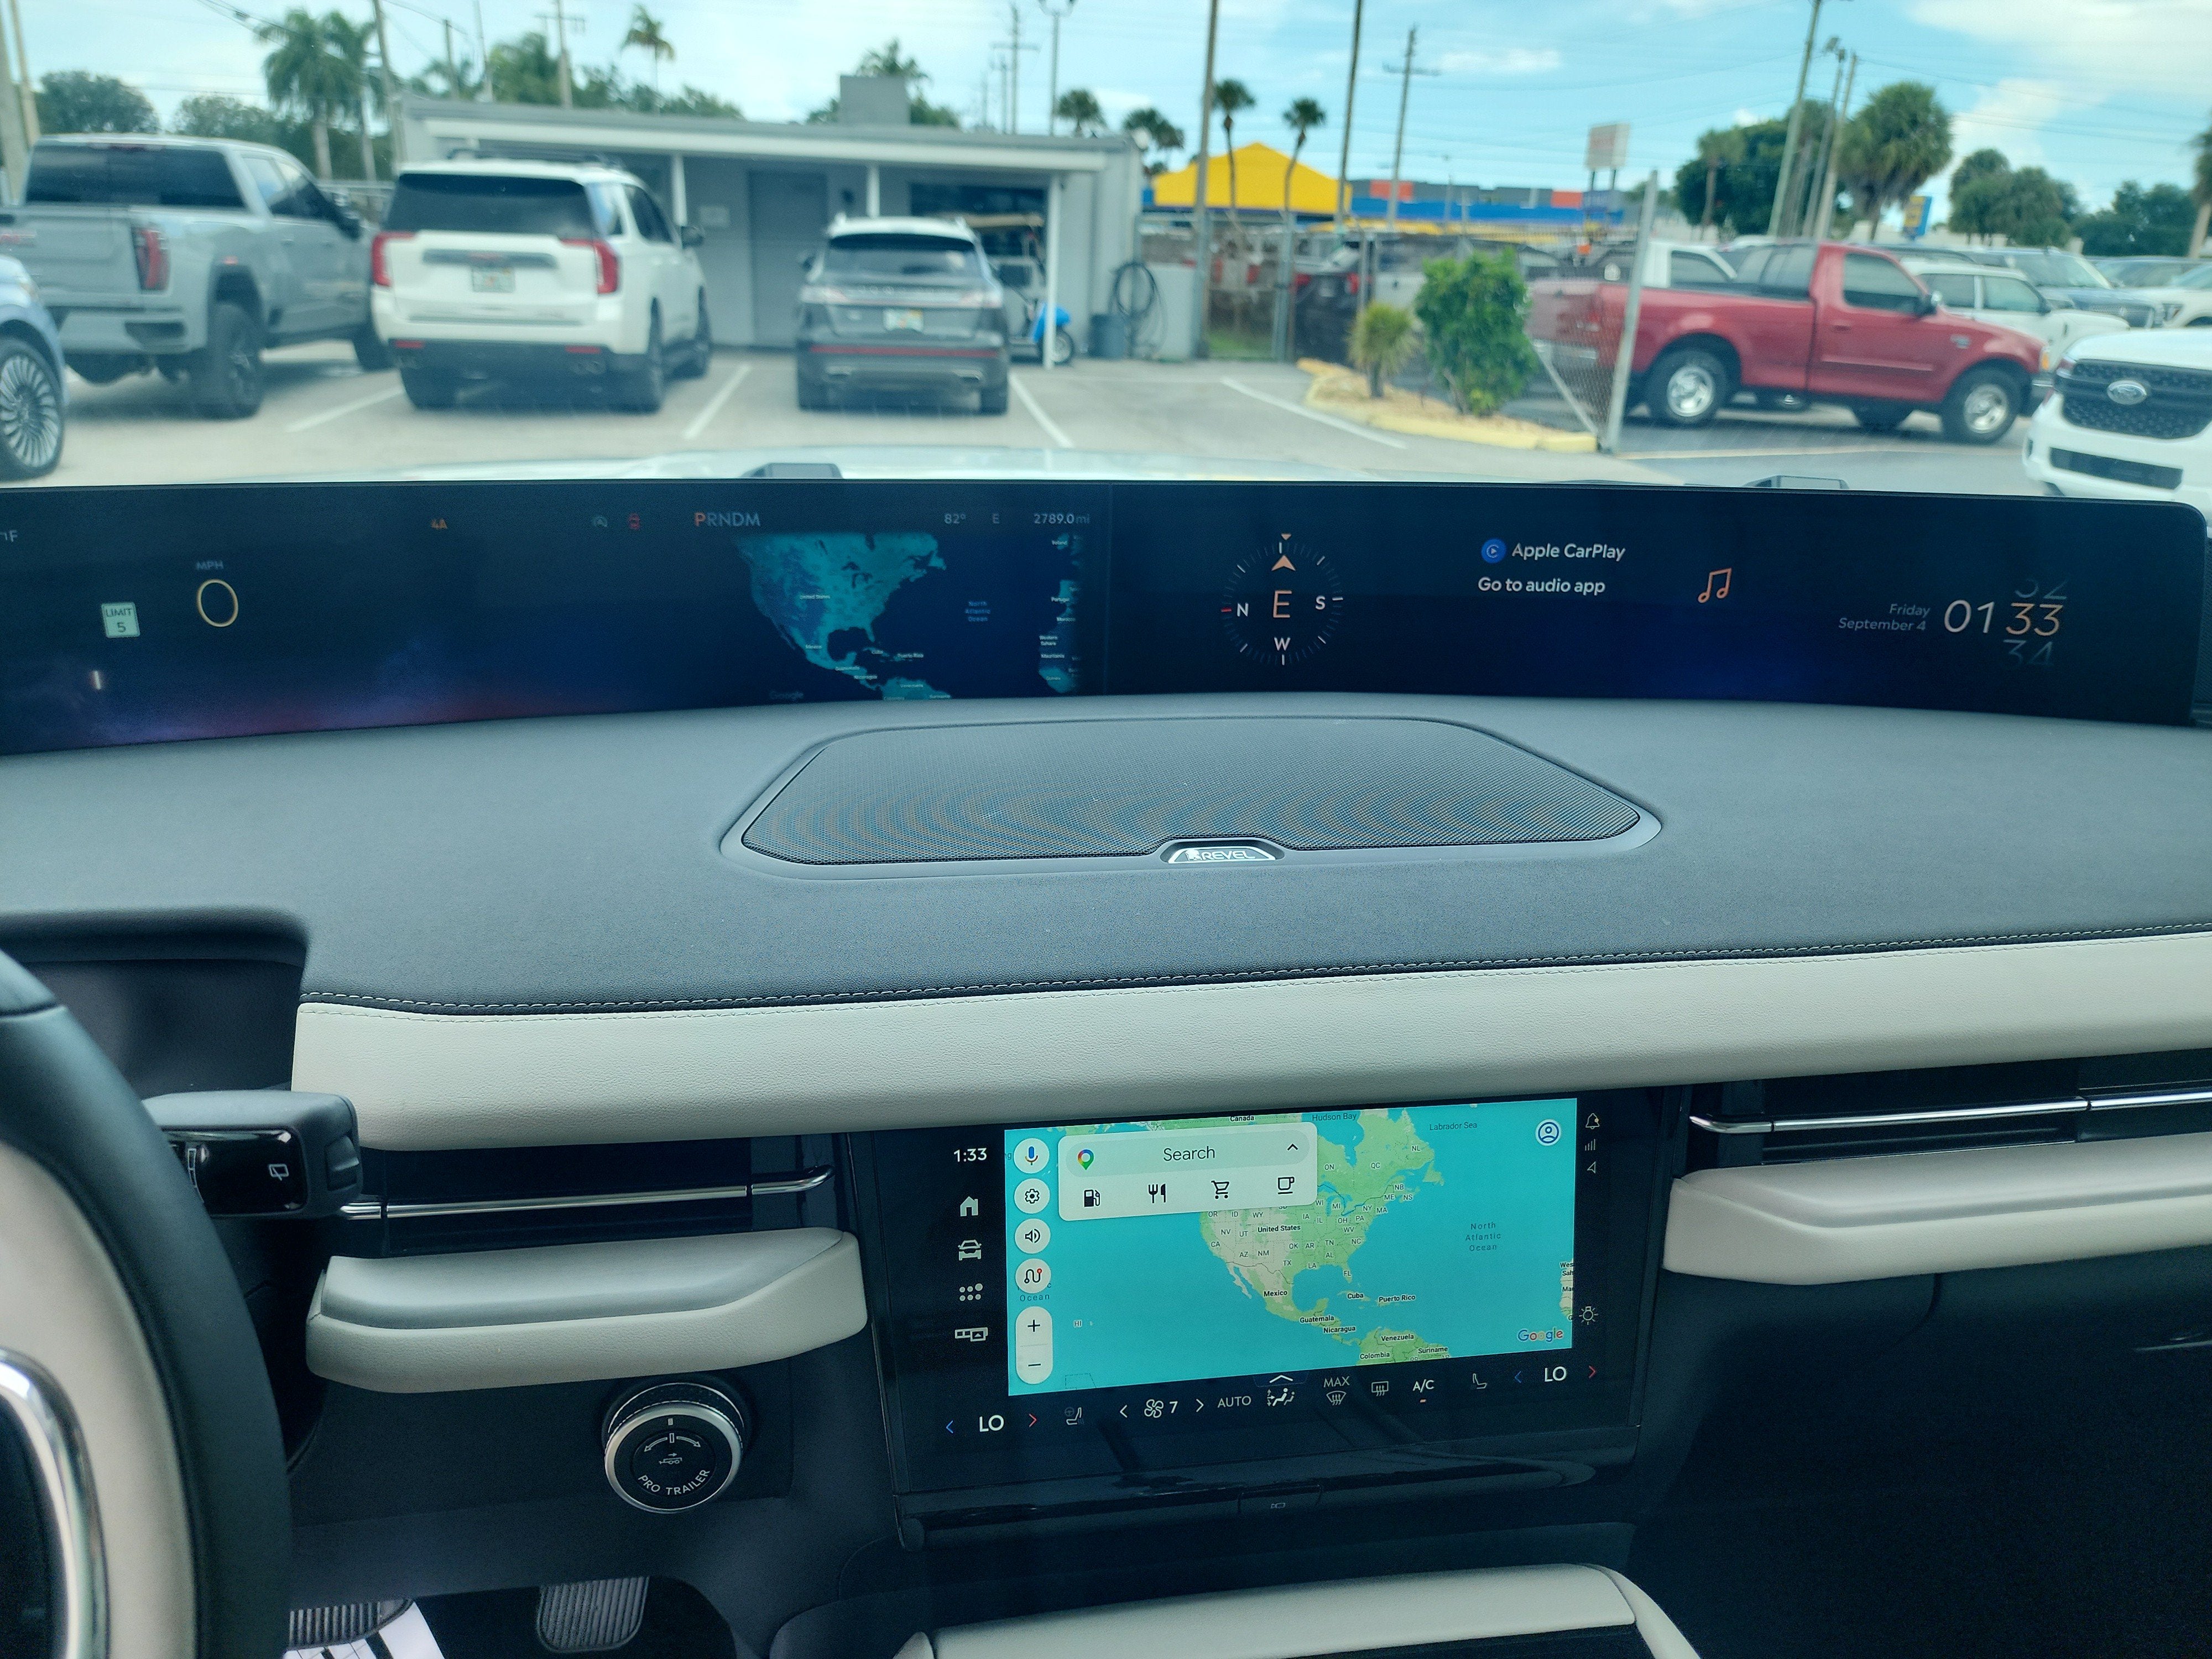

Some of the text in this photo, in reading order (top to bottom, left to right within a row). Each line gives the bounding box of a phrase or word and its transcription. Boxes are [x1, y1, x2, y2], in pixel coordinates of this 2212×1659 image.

[695, 512, 760, 526] PRNDM
[944, 514, 966, 524] 82°
[993, 514, 999, 524] E
[1034, 514, 1074, 524] 2789.0
[1512, 543, 1626, 561] Apple CarPlay
[196, 561, 223, 570] MPH
[1478, 577, 1606, 596] Go to audio app
[1237, 602, 1249, 617] N
[1273, 589, 1292, 618] E
[1316, 596, 1326, 610] S
[106, 608, 132, 617] LIMIT
[1890, 603, 1930, 618] Friday
[1838, 617, 1926, 632] September 4
[1944, 599, 2063, 637] 01 33
[117, 622, 126, 633] 5
[1274, 637, 1291, 651] W
[1201, 850, 1256, 860] REVEL
[953, 1147, 987, 1162] 1:33
[1164, 1145, 1215, 1161] Search
[1019, 1293, 1050, 1302] Ocean
[1517, 1327, 1563, 1342] Google
[1545, 1366, 1567, 1382] LO
[1324, 1376, 1350, 1388] MAX
[1413, 1379, 1434, 1393] A/C
[1169, 1401, 1178, 1413] 7
[1218, 1396, 1251, 1408] AUTO
[979, 1414, 1004, 1432] LO
[638, 1469, 710, 1495] PRO TRAILER
